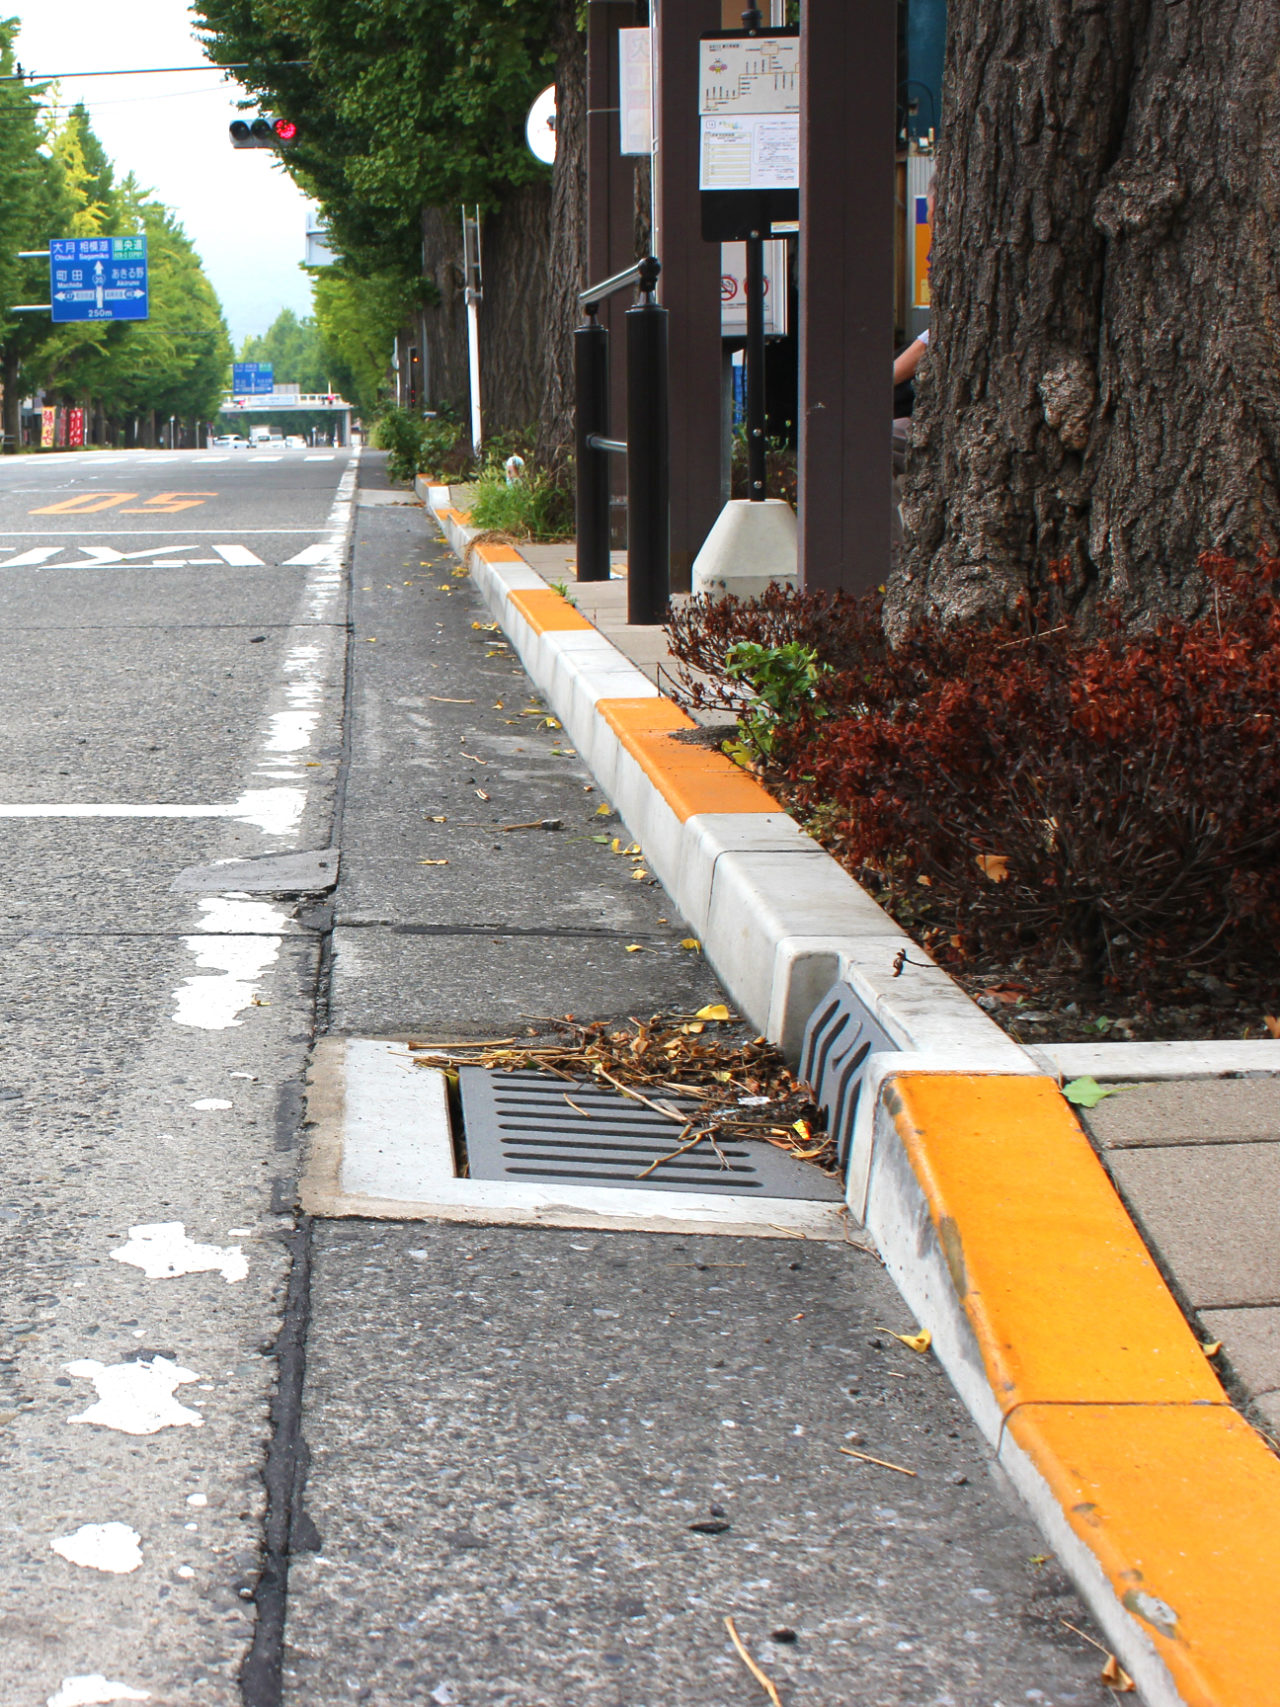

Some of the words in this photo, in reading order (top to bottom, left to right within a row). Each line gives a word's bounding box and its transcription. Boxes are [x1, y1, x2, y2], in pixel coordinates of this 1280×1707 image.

[53, 242, 76, 254] 大月
[56, 270, 83, 281] 町田
[112, 267, 145, 279] あきる野
[88, 309, 113, 317] 250m
